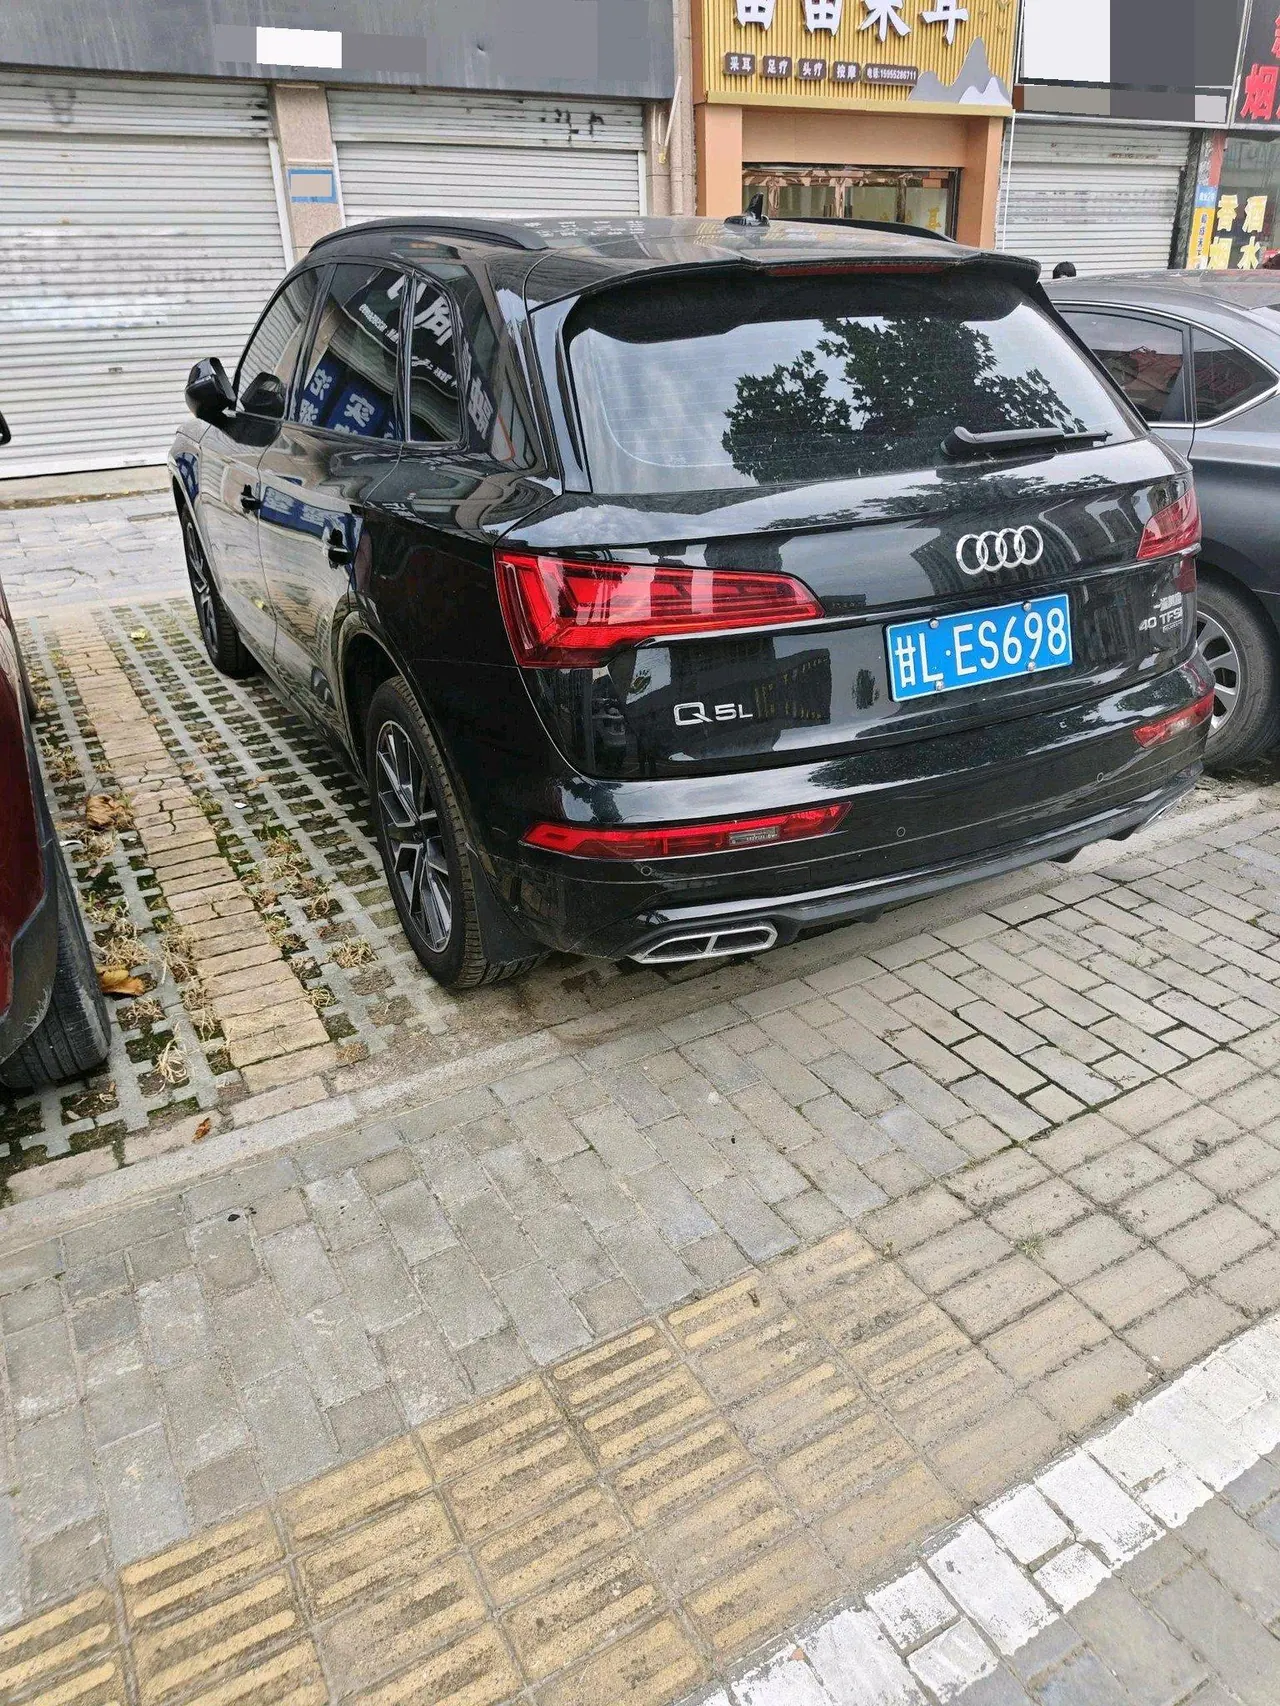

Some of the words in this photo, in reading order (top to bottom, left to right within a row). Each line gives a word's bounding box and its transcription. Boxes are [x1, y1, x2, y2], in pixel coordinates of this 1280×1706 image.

[729, 56, 752, 72] 采耳
[767, 59, 789, 75] 足疗
[802, 62, 823, 77] 头疗
[836, 64, 857, 79] 按摩
[1240, 63, 1280, 121] 烟
[1139, 616, 1157, 631] 40
